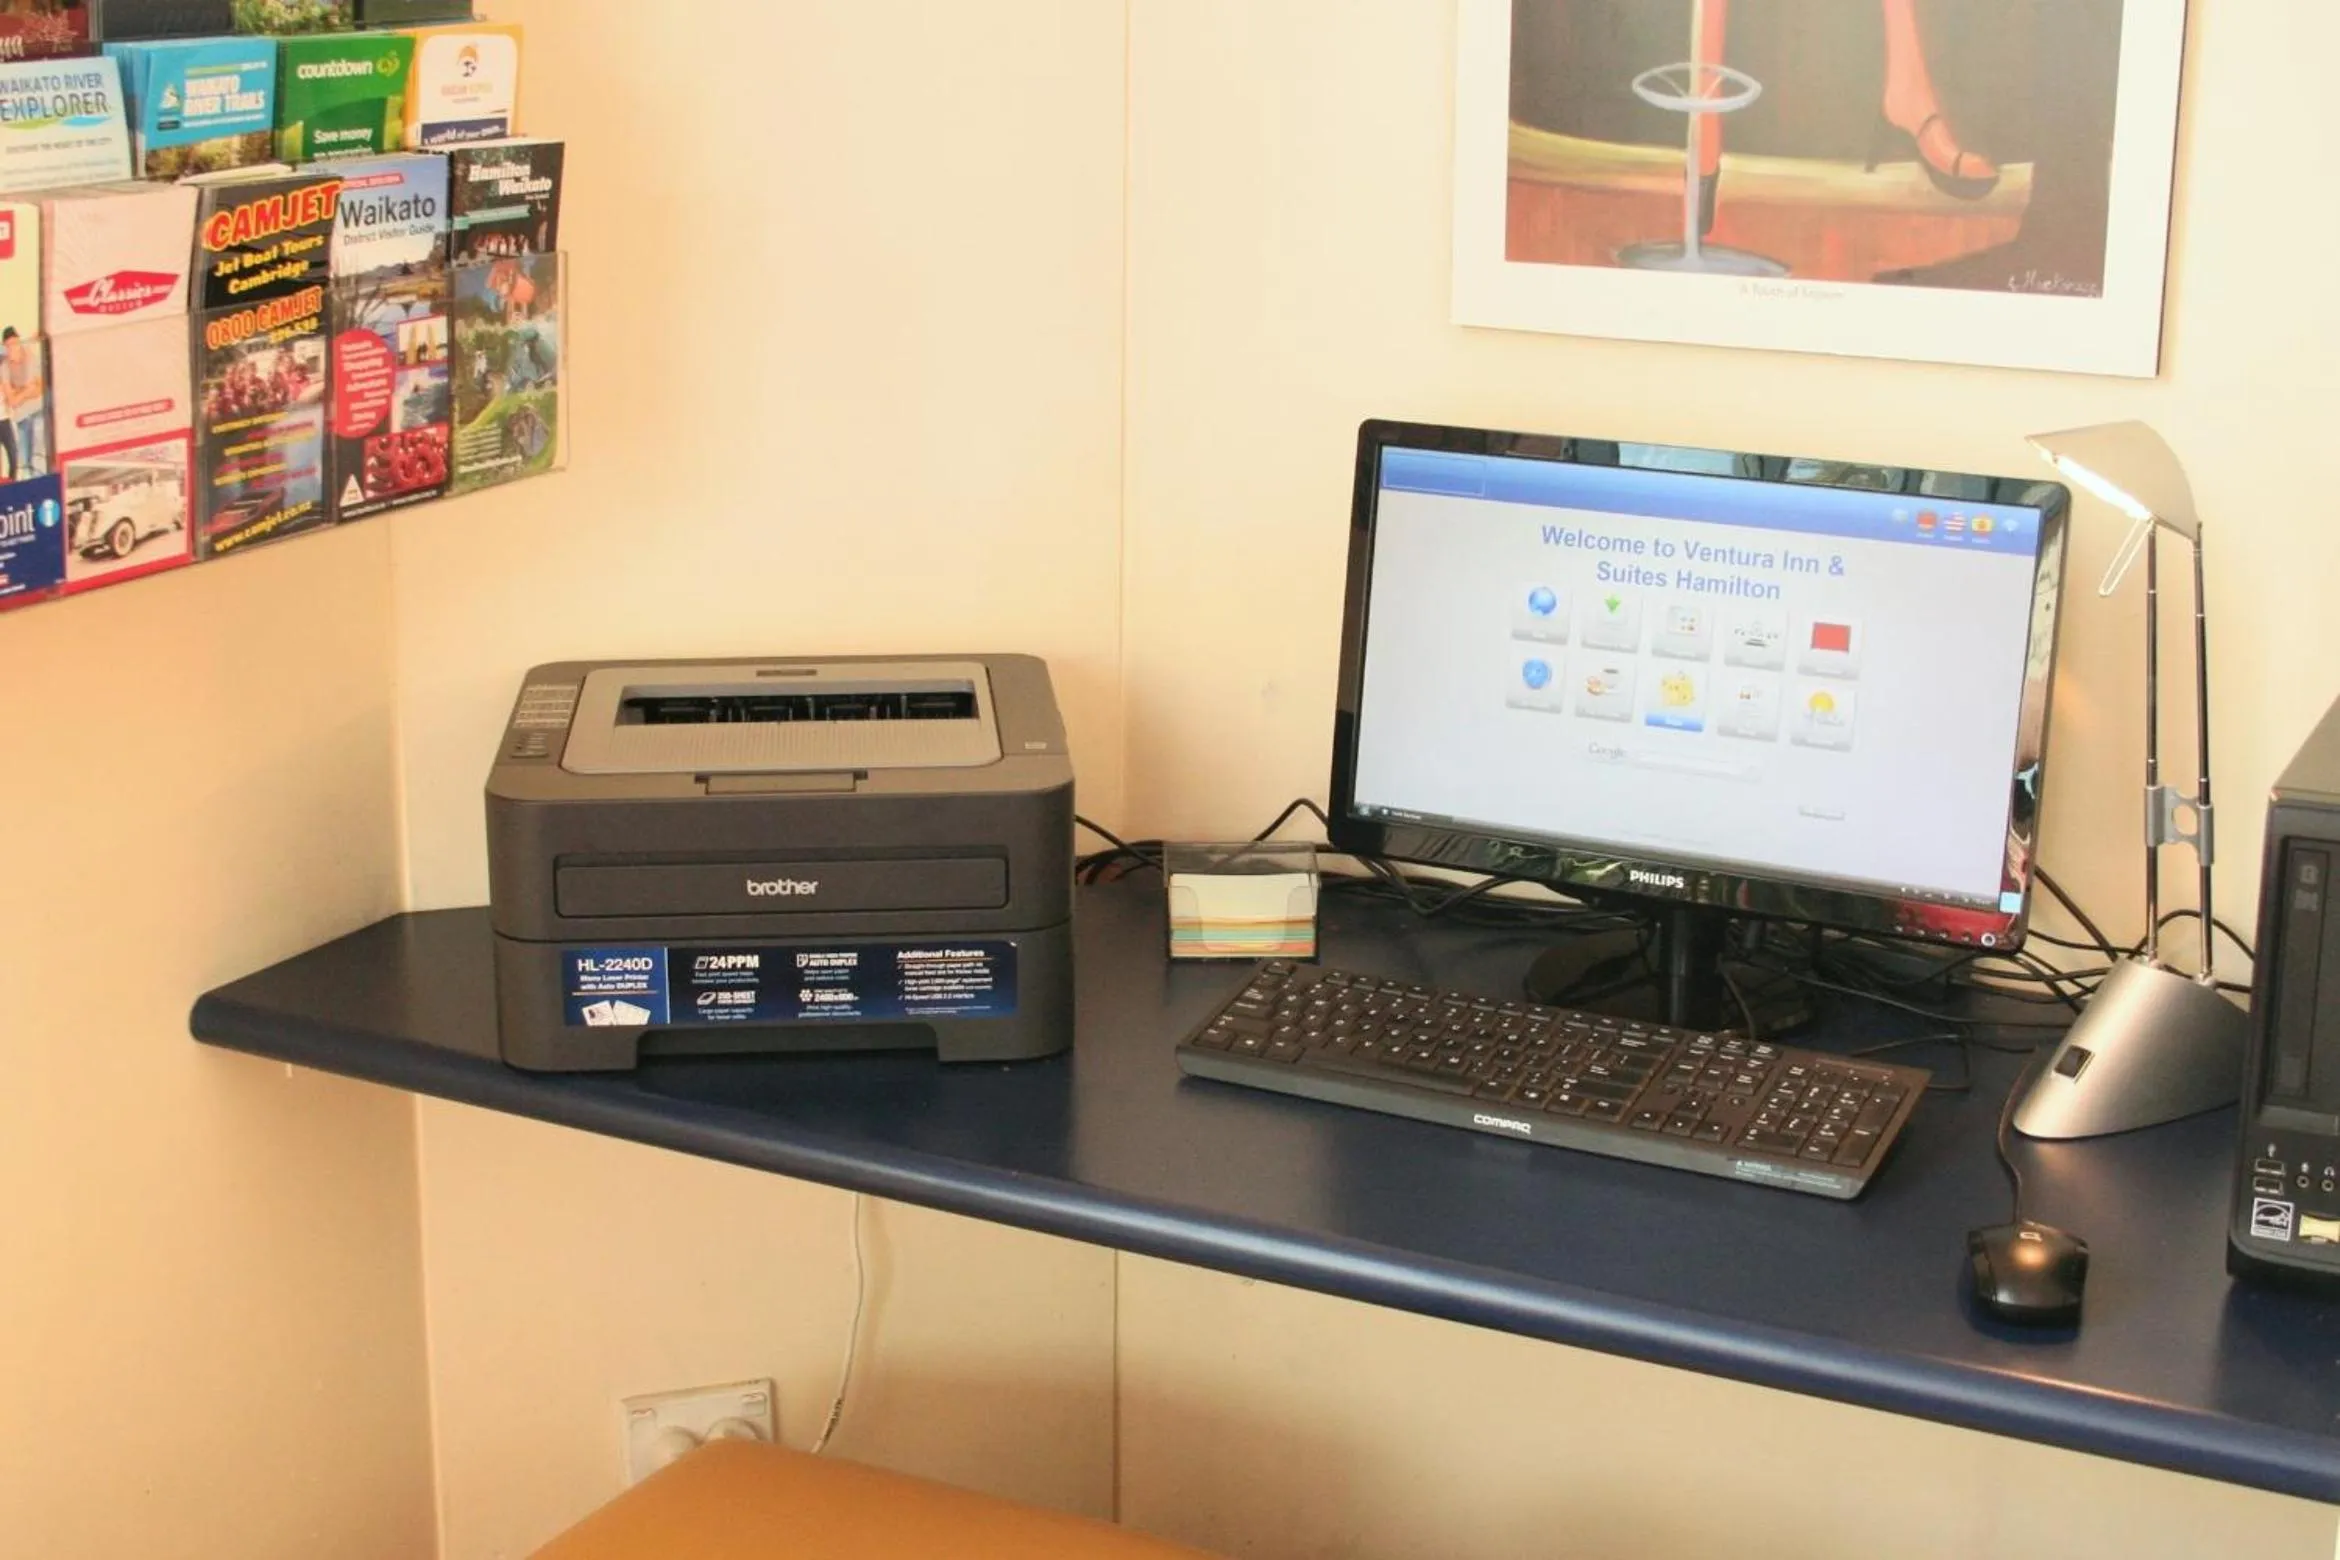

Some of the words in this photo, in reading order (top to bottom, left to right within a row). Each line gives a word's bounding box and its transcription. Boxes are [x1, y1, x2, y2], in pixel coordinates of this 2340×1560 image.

[297, 58, 373, 80] countdown
[64, 72, 104, 89] RIVER
[0, 91, 108, 121] EXPLORER
[313, 129, 338, 144] Save
[339, 127, 373, 142] money
[468, 161, 531, 182] Hamilton
[498, 176, 552, 196] Waikato
[202, 179, 343, 252] CAMJET
[340, 192, 436, 228] Waikato
[408, 224, 435, 236] Guide
[214, 257, 239, 277] Jet
[243, 245, 279, 268] Boat
[281, 235, 324, 256] Tours
[228, 260, 310, 294] Cambridge
[207, 309, 257, 350] 0800
[256, 285, 323, 331] CAMJET
[1541, 525, 1646, 555] Welcome
[1653, 538, 1675, 558] to
[1683, 539, 1775, 569] Ventura
[1783, 550, 1819, 574] Inn
[1828, 555, 1845, 576] &
[1596, 560, 1667, 587] Suites
[1676, 569, 1781, 600] Hamilton
[746, 879, 820, 896] brother
[1629, 869, 1684, 889] PHILIPS
[577, 957, 653, 972] HL-2240D
[897, 950, 943, 959] Additional
[945, 949, 985, 958] Features
[1473, 1113, 1532, 1135] COMPAQ
